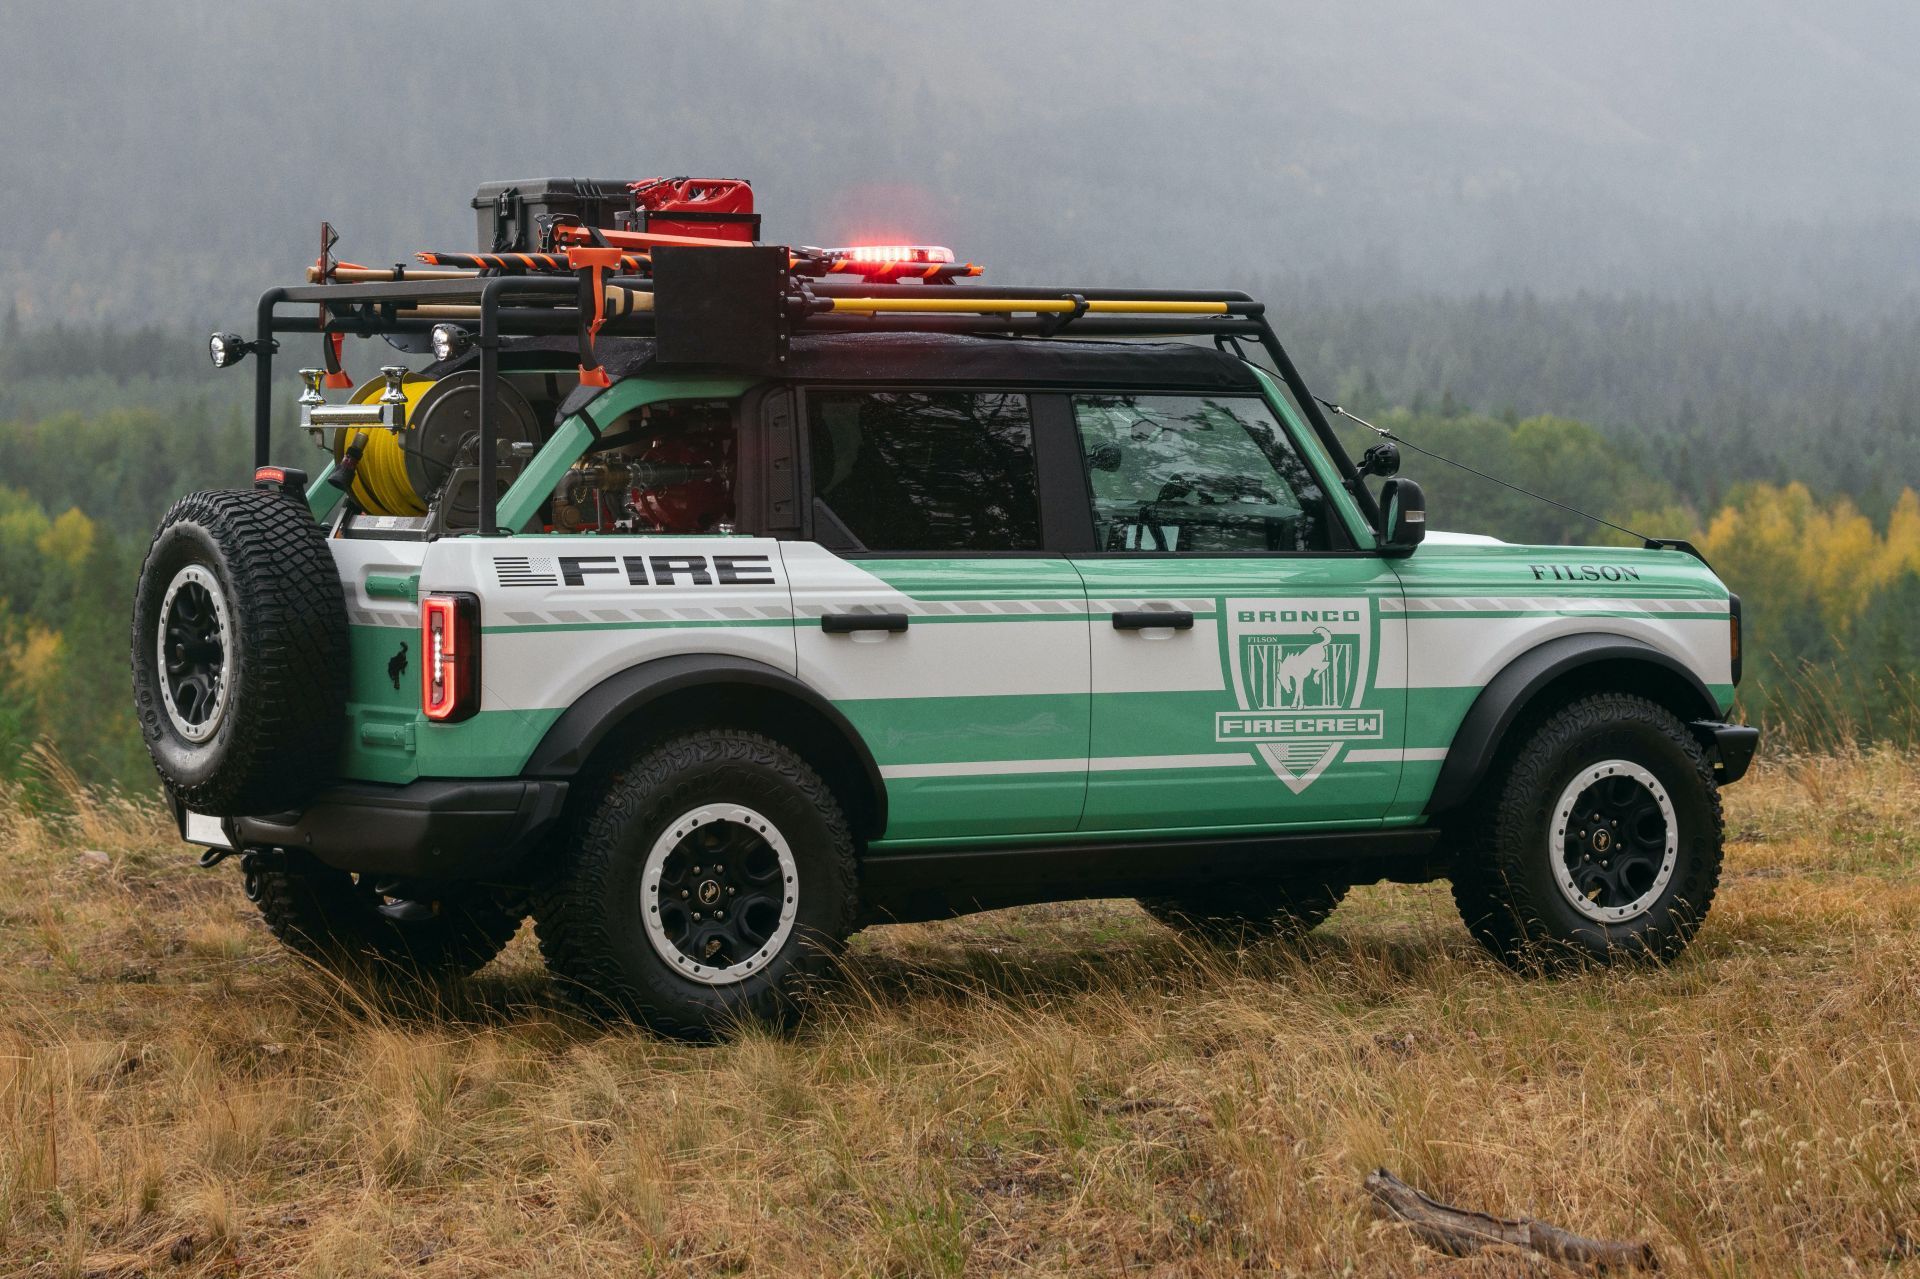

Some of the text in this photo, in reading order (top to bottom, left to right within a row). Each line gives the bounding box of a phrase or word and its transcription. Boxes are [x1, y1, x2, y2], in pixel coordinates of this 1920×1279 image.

[558, 555, 776, 587] FIRE
[1528, 564, 1641, 582] FILSON
[1238, 610, 1360, 623] BRONCO
[1223, 718, 1377, 734] FIRECREW
